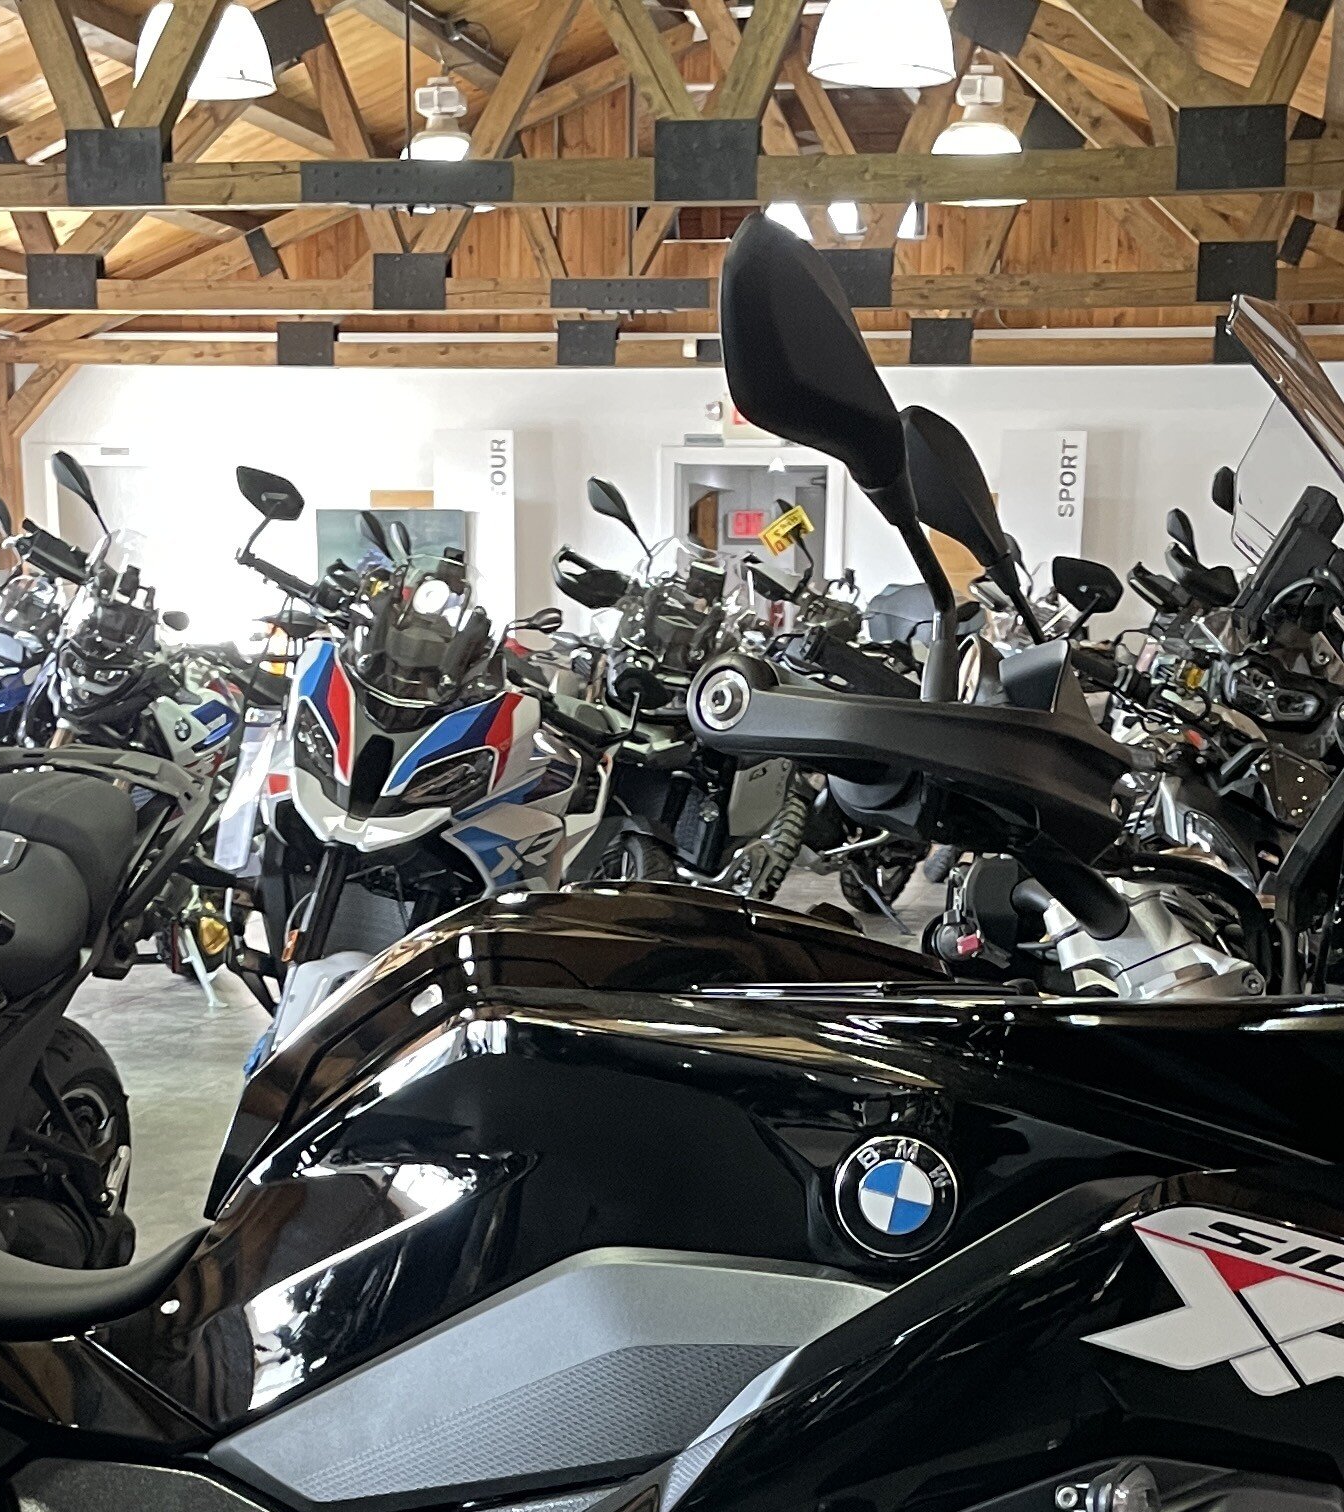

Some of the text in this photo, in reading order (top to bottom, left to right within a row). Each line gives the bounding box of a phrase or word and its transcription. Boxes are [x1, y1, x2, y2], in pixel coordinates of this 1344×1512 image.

[490, 439, 507, 496] OUR
[1057, 438, 1078, 517] SPORT
[856, 1138, 953, 1189] BMW
